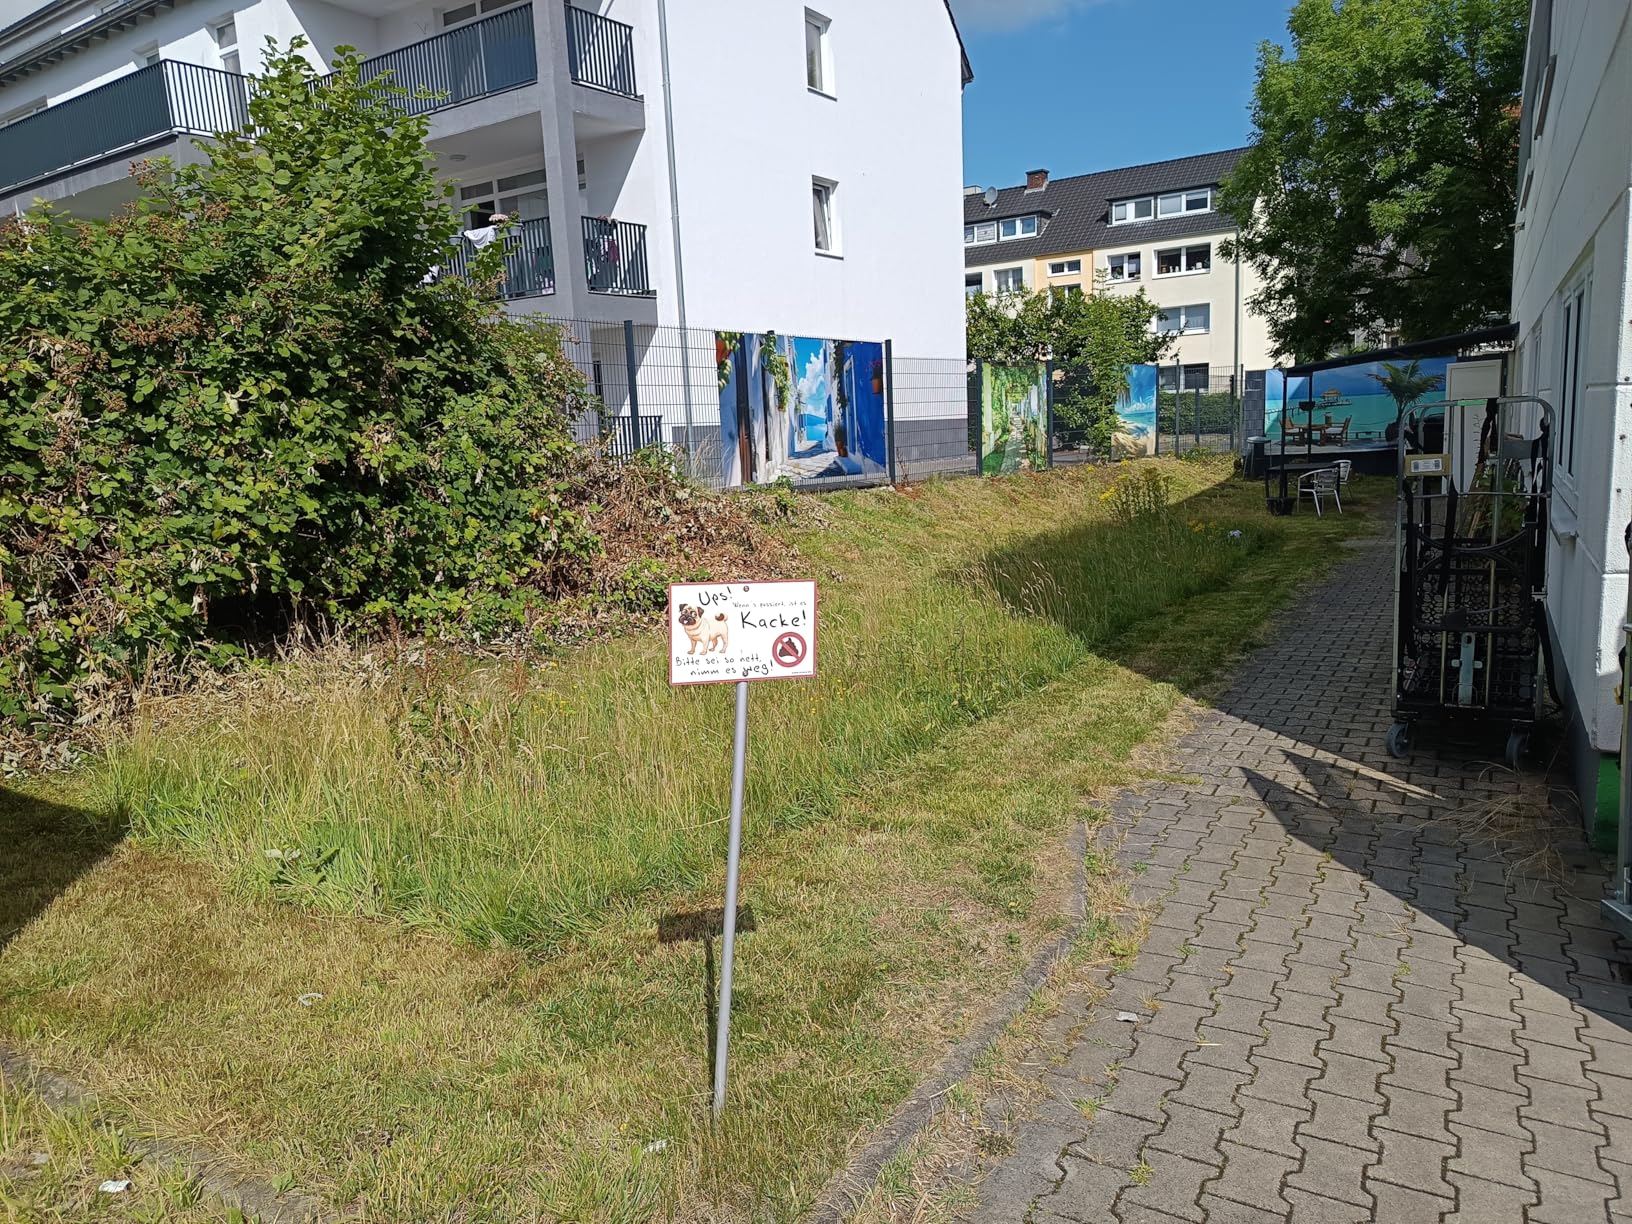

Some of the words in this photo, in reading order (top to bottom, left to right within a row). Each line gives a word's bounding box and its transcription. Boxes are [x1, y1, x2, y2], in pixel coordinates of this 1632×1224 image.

[698, 586, 733, 606] Ups!
[740, 609, 807, 629] Kacke!
[675, 656, 700, 667] Bitte
[705, 656, 720, 665] sei
[690, 668, 720, 676] nimm
[742, 659, 774, 676] weg!
